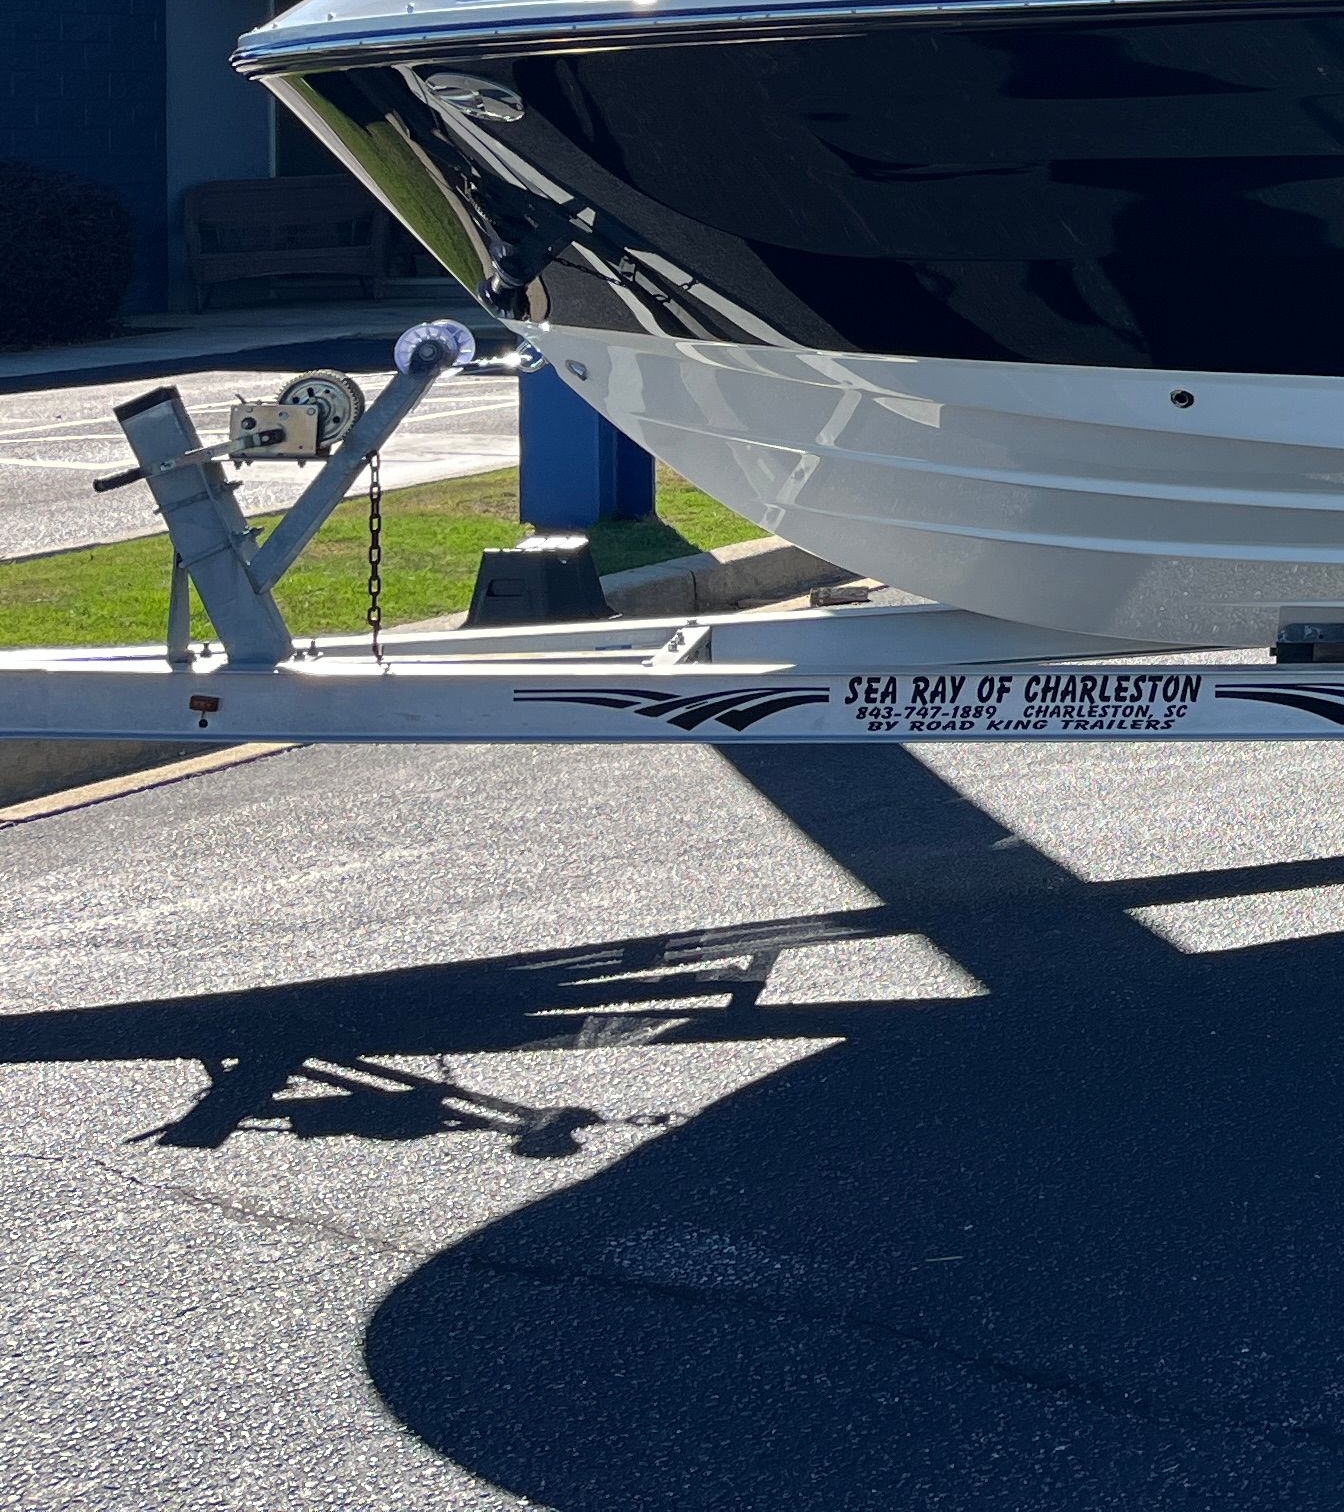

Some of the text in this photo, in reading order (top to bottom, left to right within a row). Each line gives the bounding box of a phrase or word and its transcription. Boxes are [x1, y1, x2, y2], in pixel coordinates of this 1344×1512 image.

[844, 674, 1202, 705] SEA RAY OF CHARLESTON
[855, 704, 1188, 720] 843-747-1889 CHARLESTON, SC
[867, 719, 1176, 732] BY ROAD KING TRAILERS
